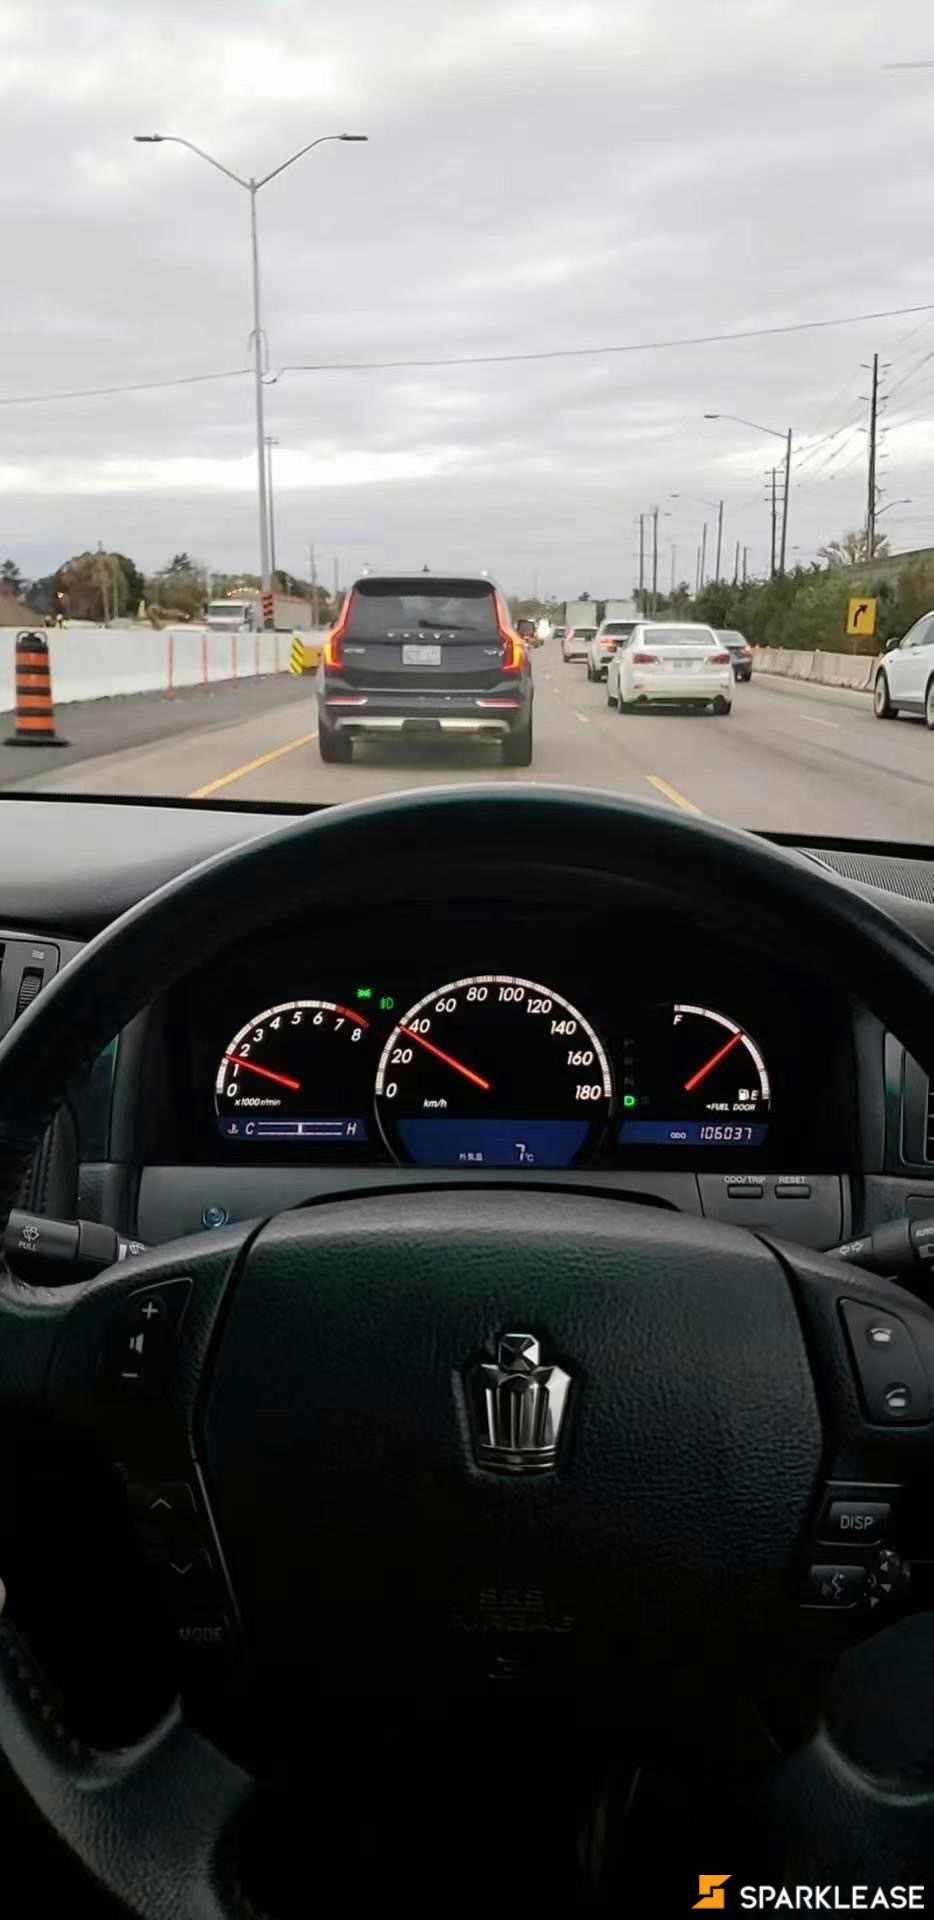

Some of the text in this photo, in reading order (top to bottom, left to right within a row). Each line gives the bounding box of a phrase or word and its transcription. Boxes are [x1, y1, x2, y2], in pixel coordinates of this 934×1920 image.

[466, 987, 488, 1001] 80
[498, 987, 524, 1002] 100
[435, 998, 456, 1013] 60
[527, 999, 552, 1014] 120
[270, 1017, 281, 1030] 4
[291, 1012, 302, 1024] 5
[313, 1012, 323, 1025] 6
[334, 1018, 345, 1031] 7
[673, 1014, 684, 1025] F
[409, 1018, 430, 1034] 40
[551, 1020, 577, 1036] 140
[253, 1029, 264, 1042] 3
[351, 1028, 362, 1042] 8
[239, 1044, 250, 1057] 2
[391, 1048, 413, 1064] 20
[567, 1050, 593, 1066] 160
[233, 1063, 240, 1077] 1
[226, 1083, 238, 1097] 0
[386, 1083, 397, 1098] 0
[575, 1084, 601, 1100] 180
[750, 1089, 759, 1101] E
[423, 1098, 447, 1108] km/h
[623, 1095, 635, 1106] D
[710, 1102, 756, 1111] FUEL DOOR
[244, 1122, 255, 1135] C
[346, 1122, 357, 1135] H
[699, 1126, 752, 1140] 106037
[778, 1175, 808, 1184] RESET
[840, 1515, 874, 1530] DISP
